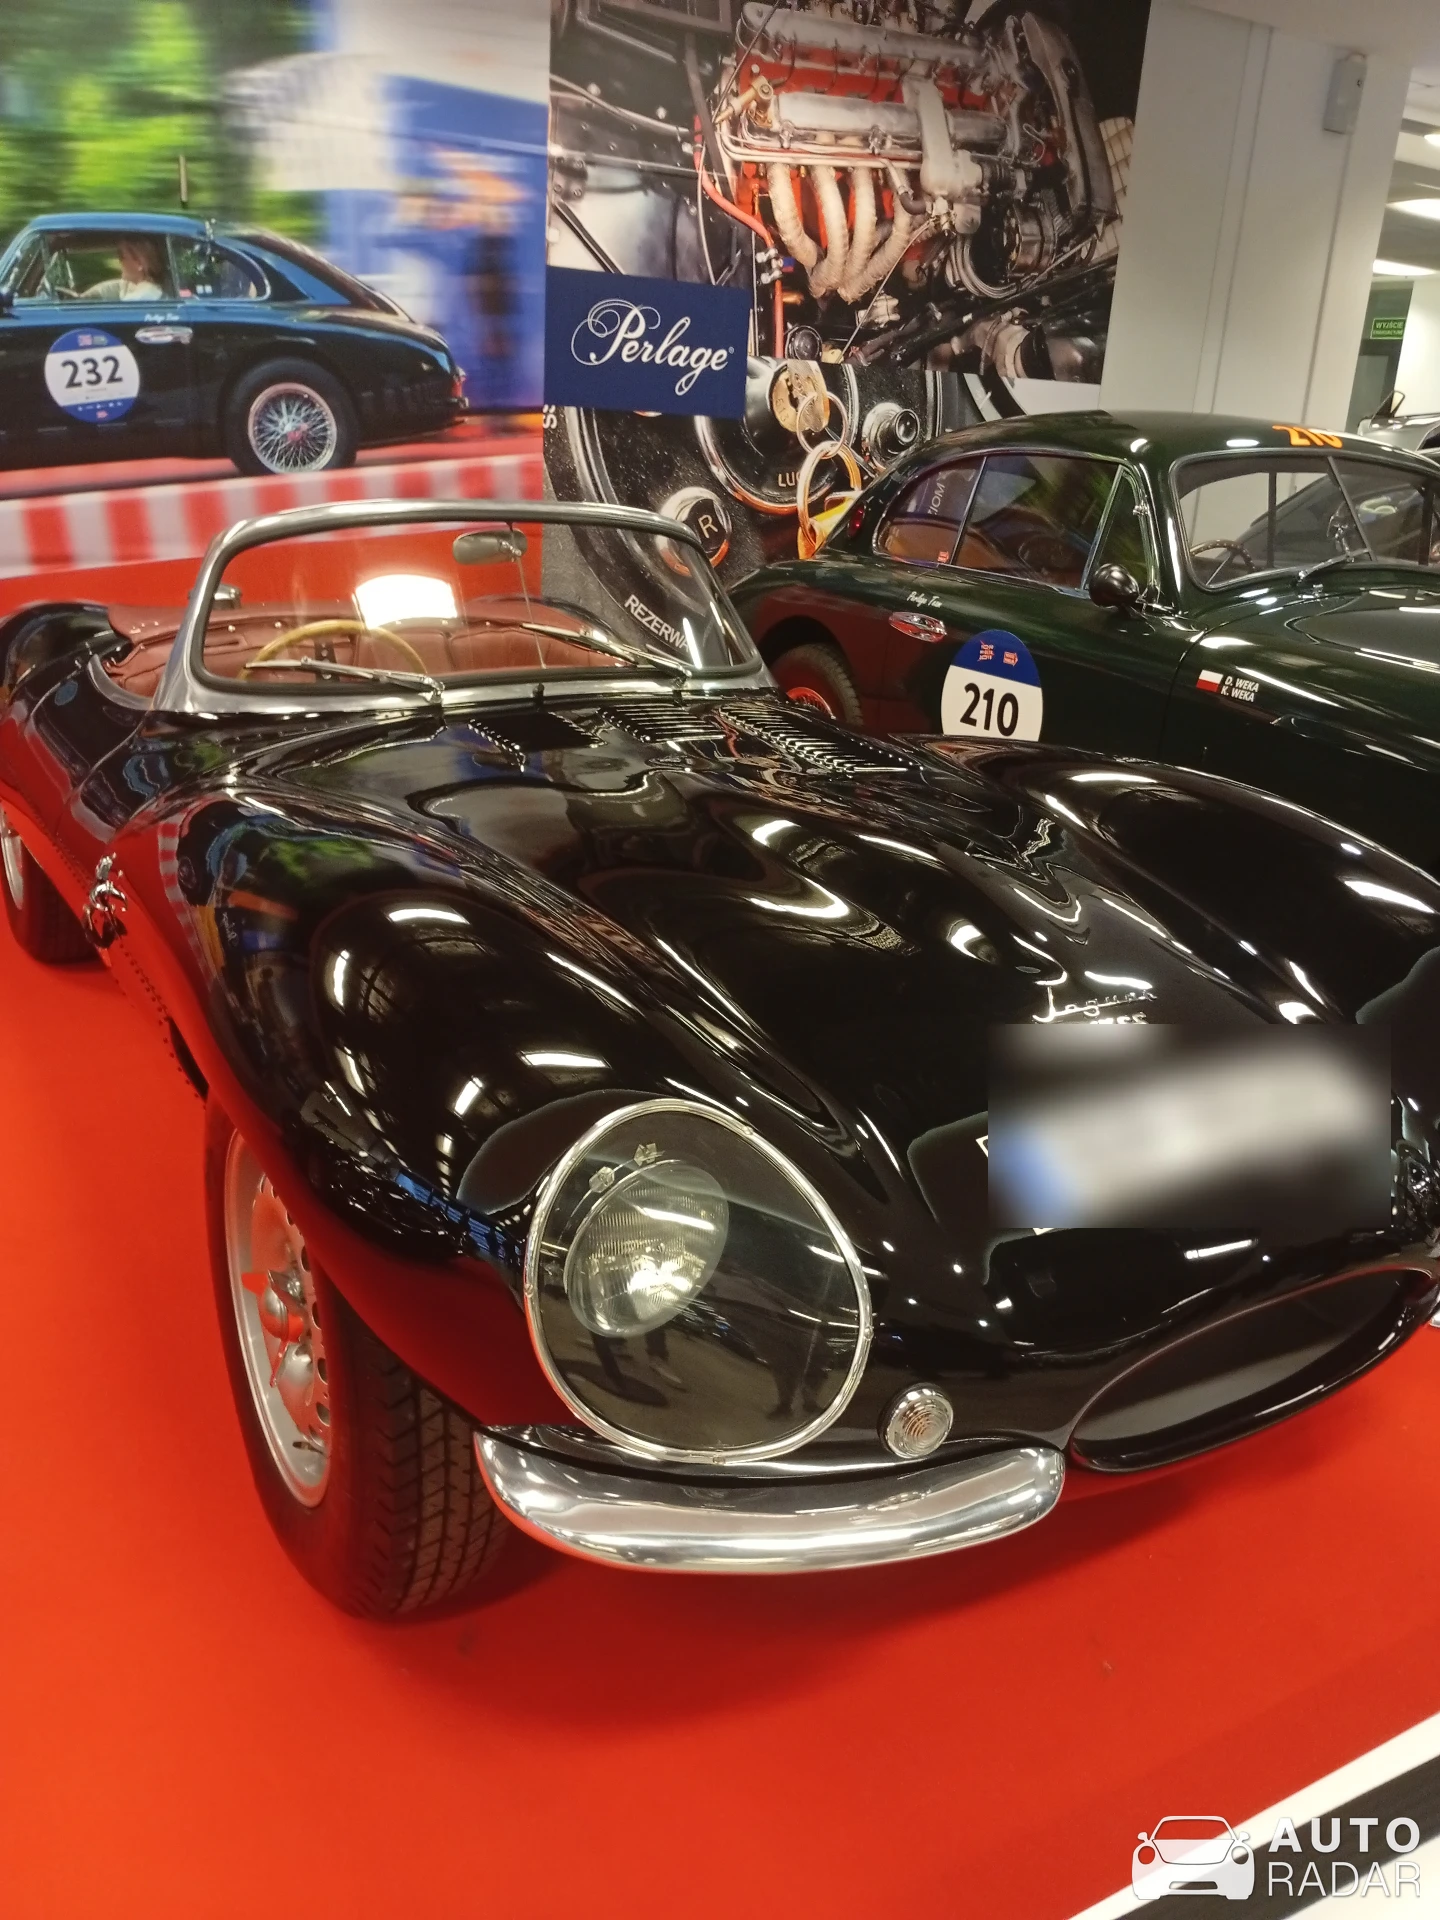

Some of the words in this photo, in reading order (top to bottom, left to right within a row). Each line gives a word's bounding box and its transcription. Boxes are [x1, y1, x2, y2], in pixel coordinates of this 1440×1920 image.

[61, 355, 123, 389] 232
[698, 514, 719, 539] R
[1231, 687, 1255, 703] WEKA
[1235, 678, 1260, 693] WEKA
[960, 682, 1019, 737] 210
